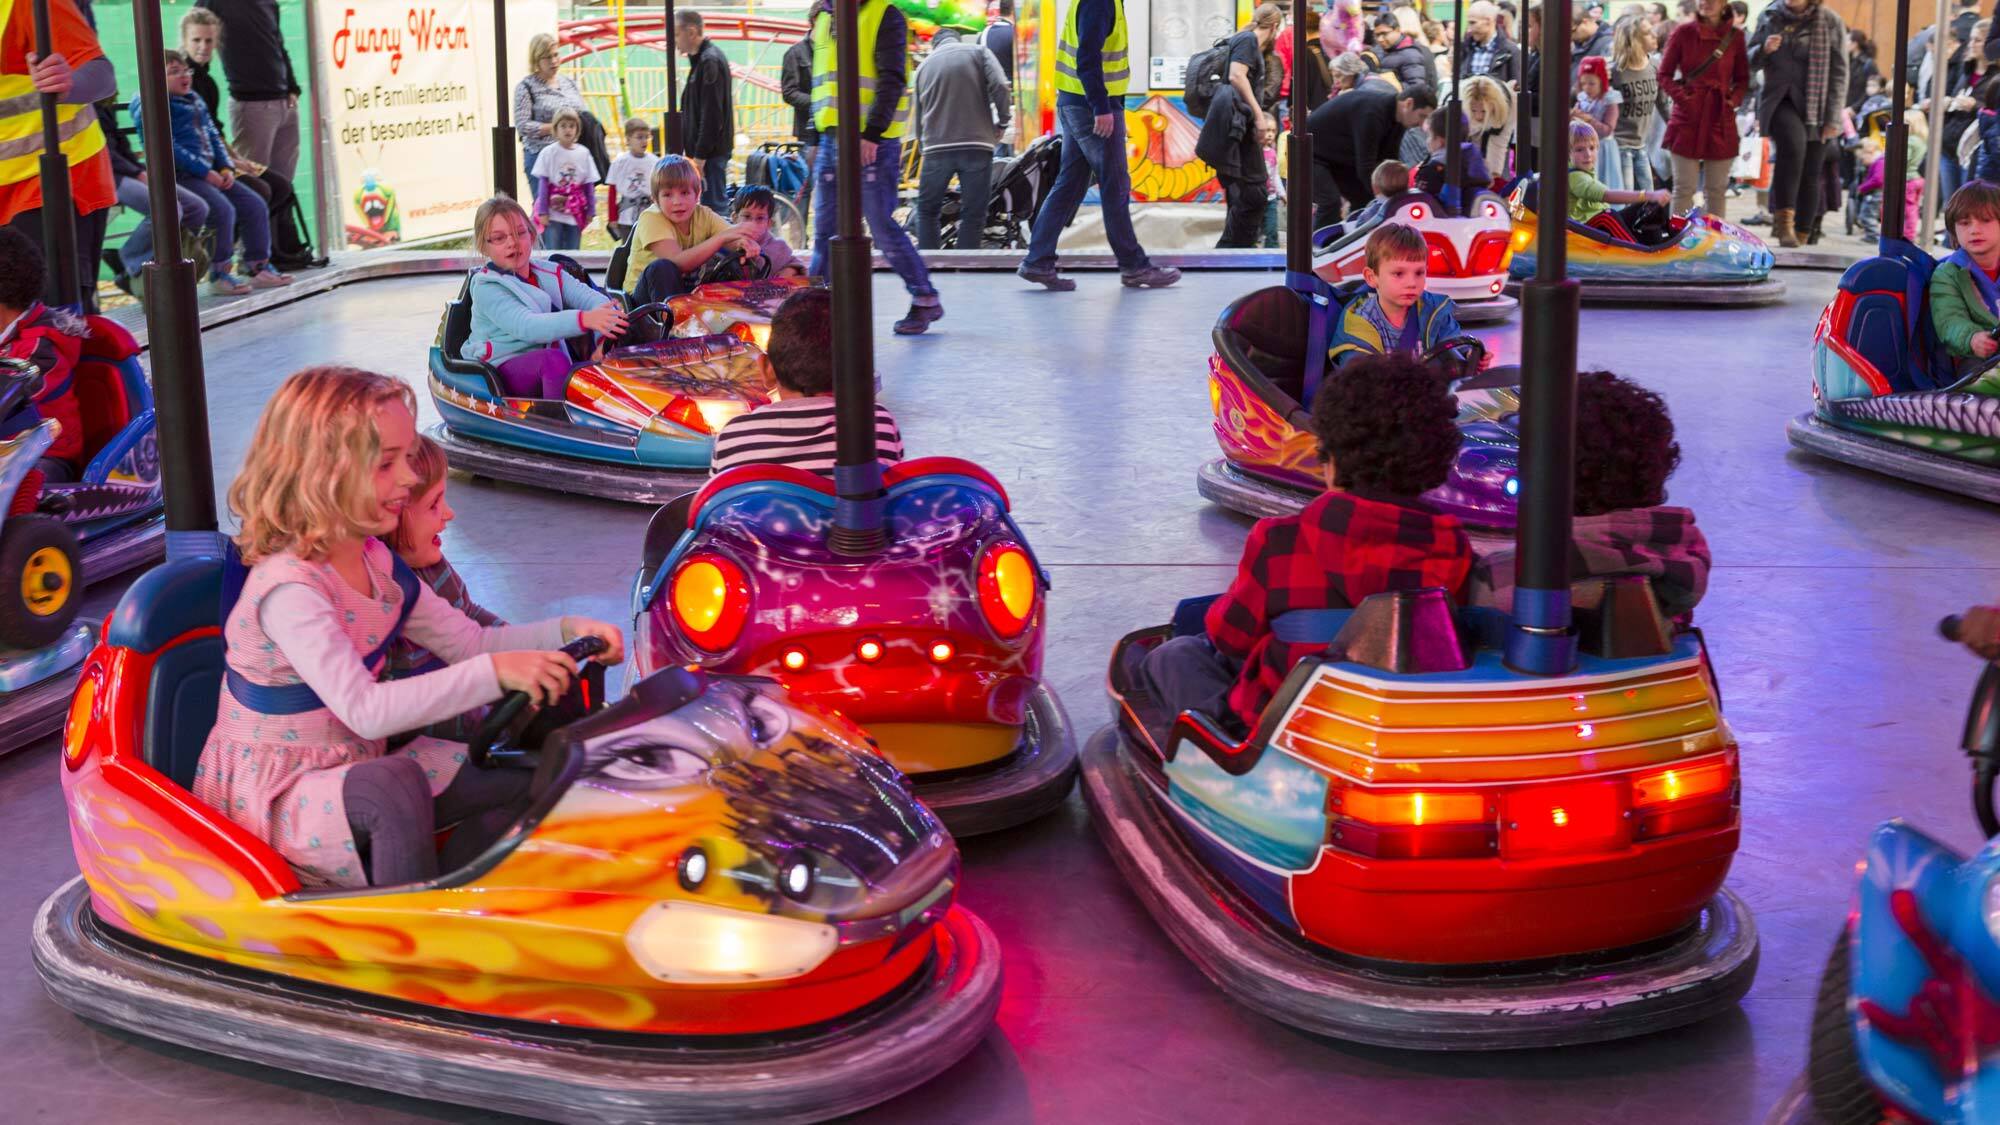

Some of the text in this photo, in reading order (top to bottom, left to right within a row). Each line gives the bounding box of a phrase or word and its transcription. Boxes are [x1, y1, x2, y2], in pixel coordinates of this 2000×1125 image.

[333, 9, 468, 75] Funny Worm
[344, 82, 467, 110] Die Familienbahn
[341, 112, 476, 144] der besonderen Art
